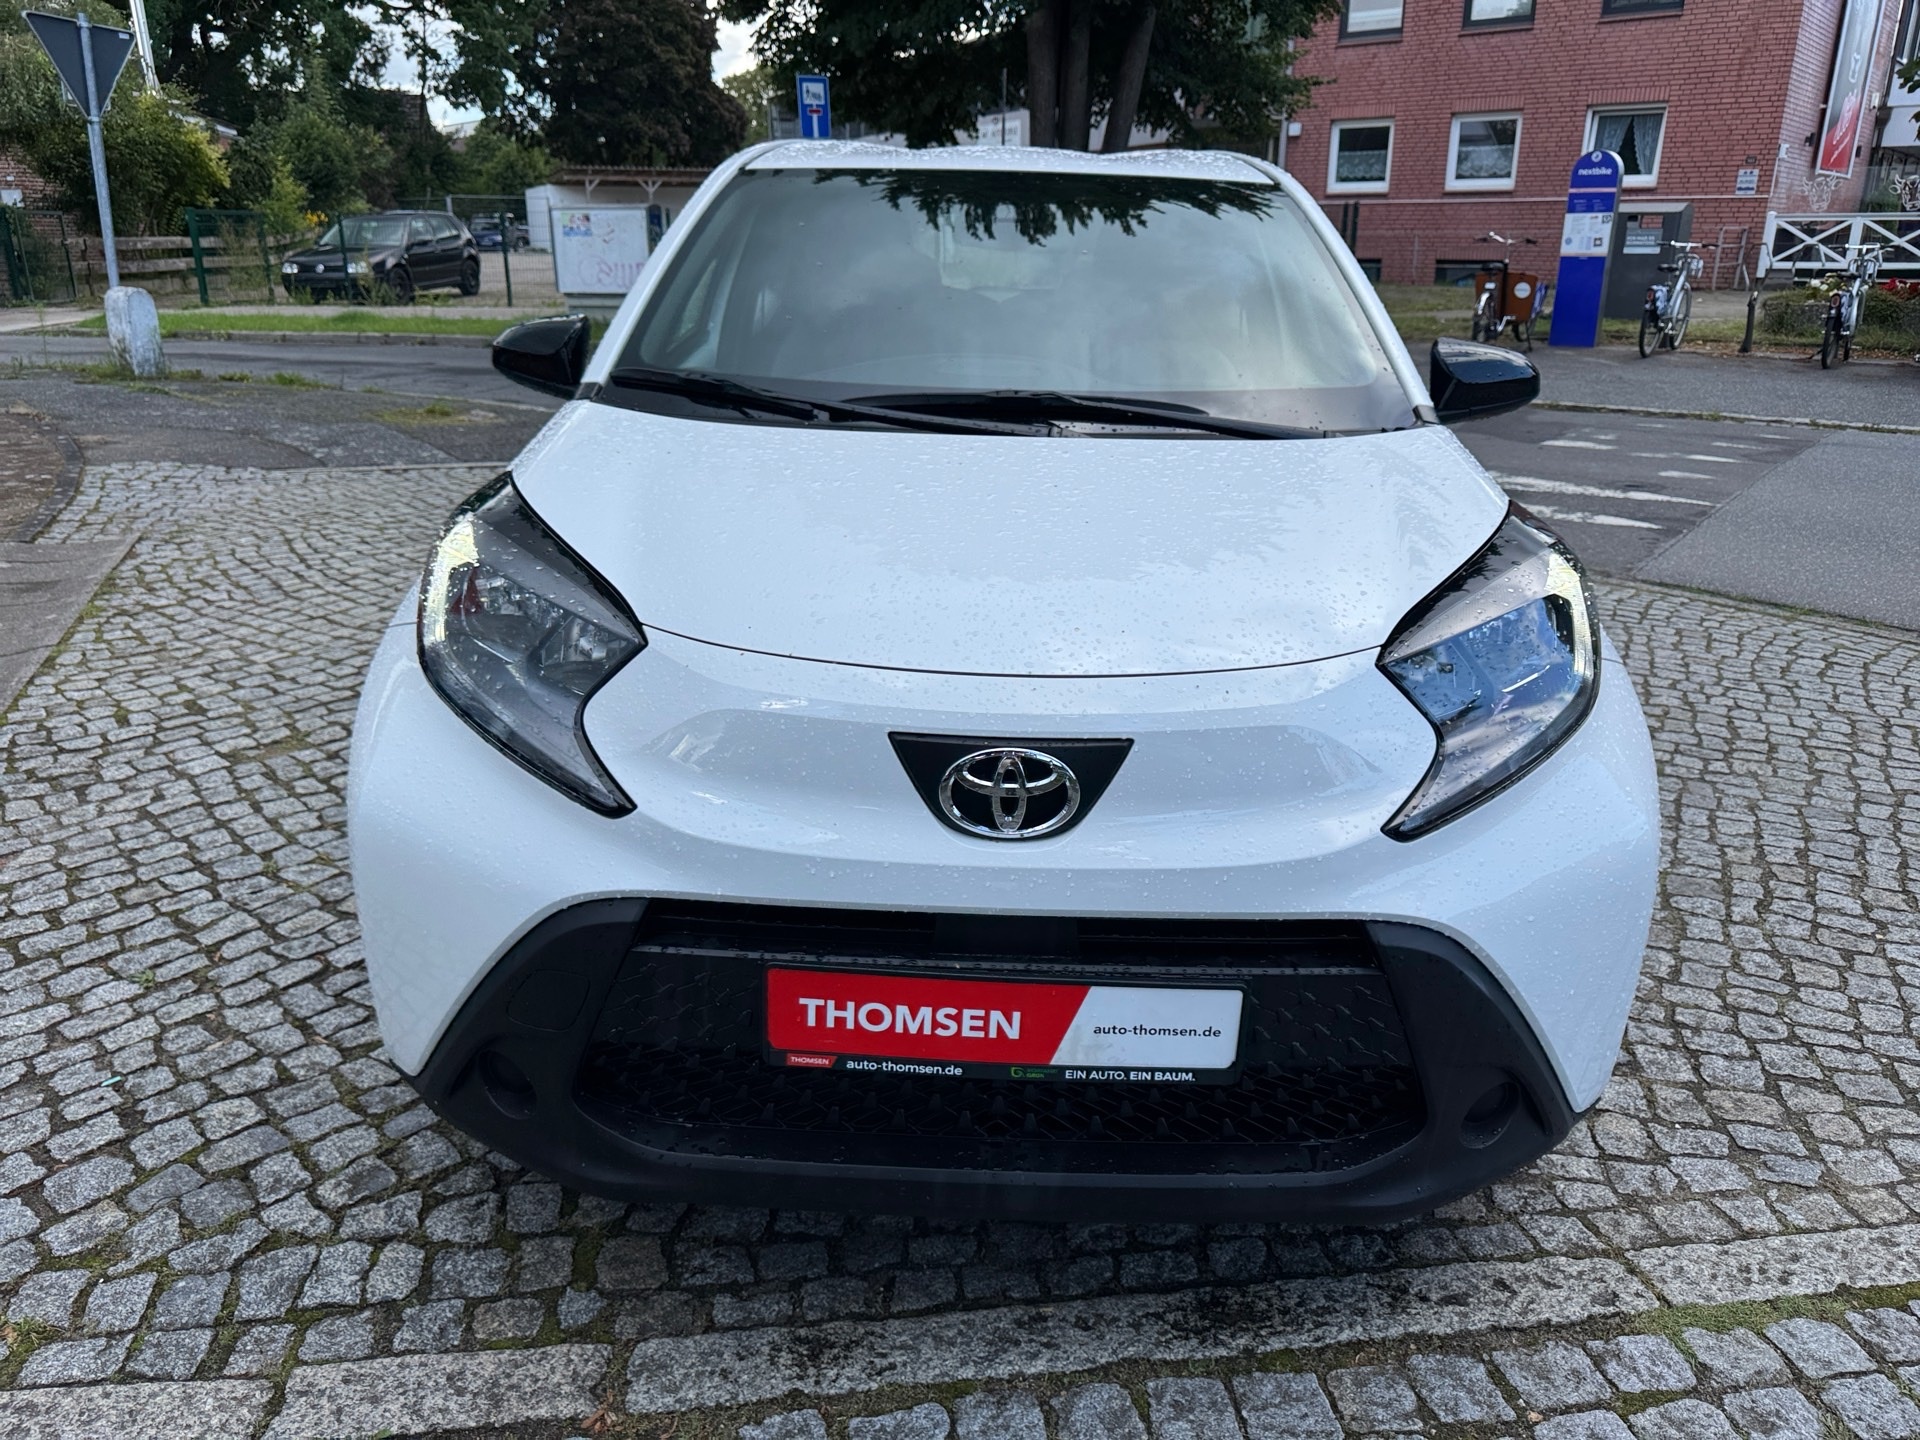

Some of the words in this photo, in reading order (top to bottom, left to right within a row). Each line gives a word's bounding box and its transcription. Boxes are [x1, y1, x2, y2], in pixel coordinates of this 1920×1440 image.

[798, 997, 1022, 1040] THOMSEN
[1093, 1024, 1222, 1038] auto-thomsen.de
[790, 1056, 830, 1066] THOMSEN
[846, 1059, 963, 1076] auto-thomsen.de
[1065, 1069, 1087, 1080] EIN
[1089, 1070, 1127, 1081] AUTO.
[1129, 1071, 1151, 1081] EIN
[1154, 1072, 1196, 1082] BAUM.
